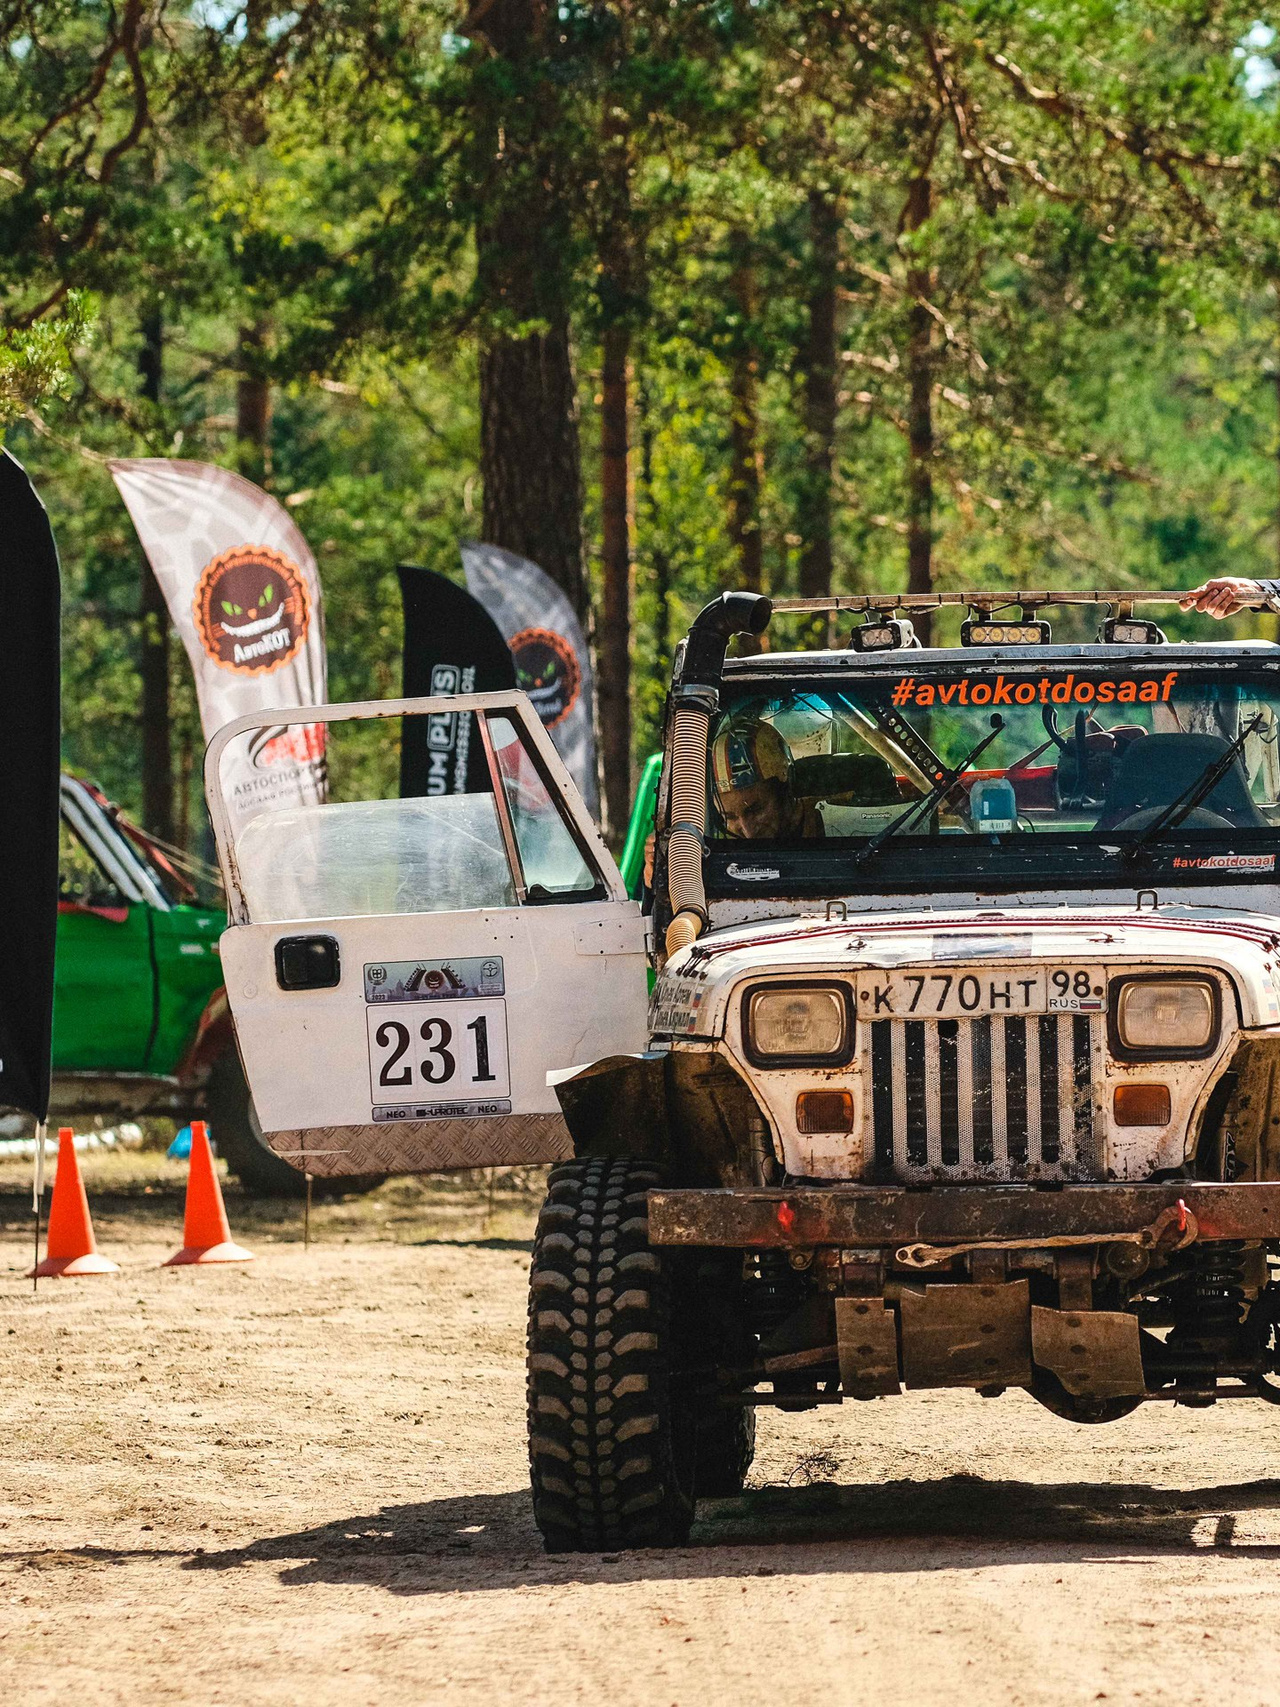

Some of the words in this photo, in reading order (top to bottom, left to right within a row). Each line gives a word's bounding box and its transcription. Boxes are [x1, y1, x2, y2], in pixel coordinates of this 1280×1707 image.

[891, 672, 1178, 706] #avtokotdosaaf
[1172, 854, 1276, 868] #avtokotdosaaf
[1052, 970, 1090, 998] 98
[1050, 998, 1078, 1009] RUS
[375, 1015, 496, 1087] 231
[386, 1111, 406, 1119] NEO
[477, 1105, 498, 1114] NEO
